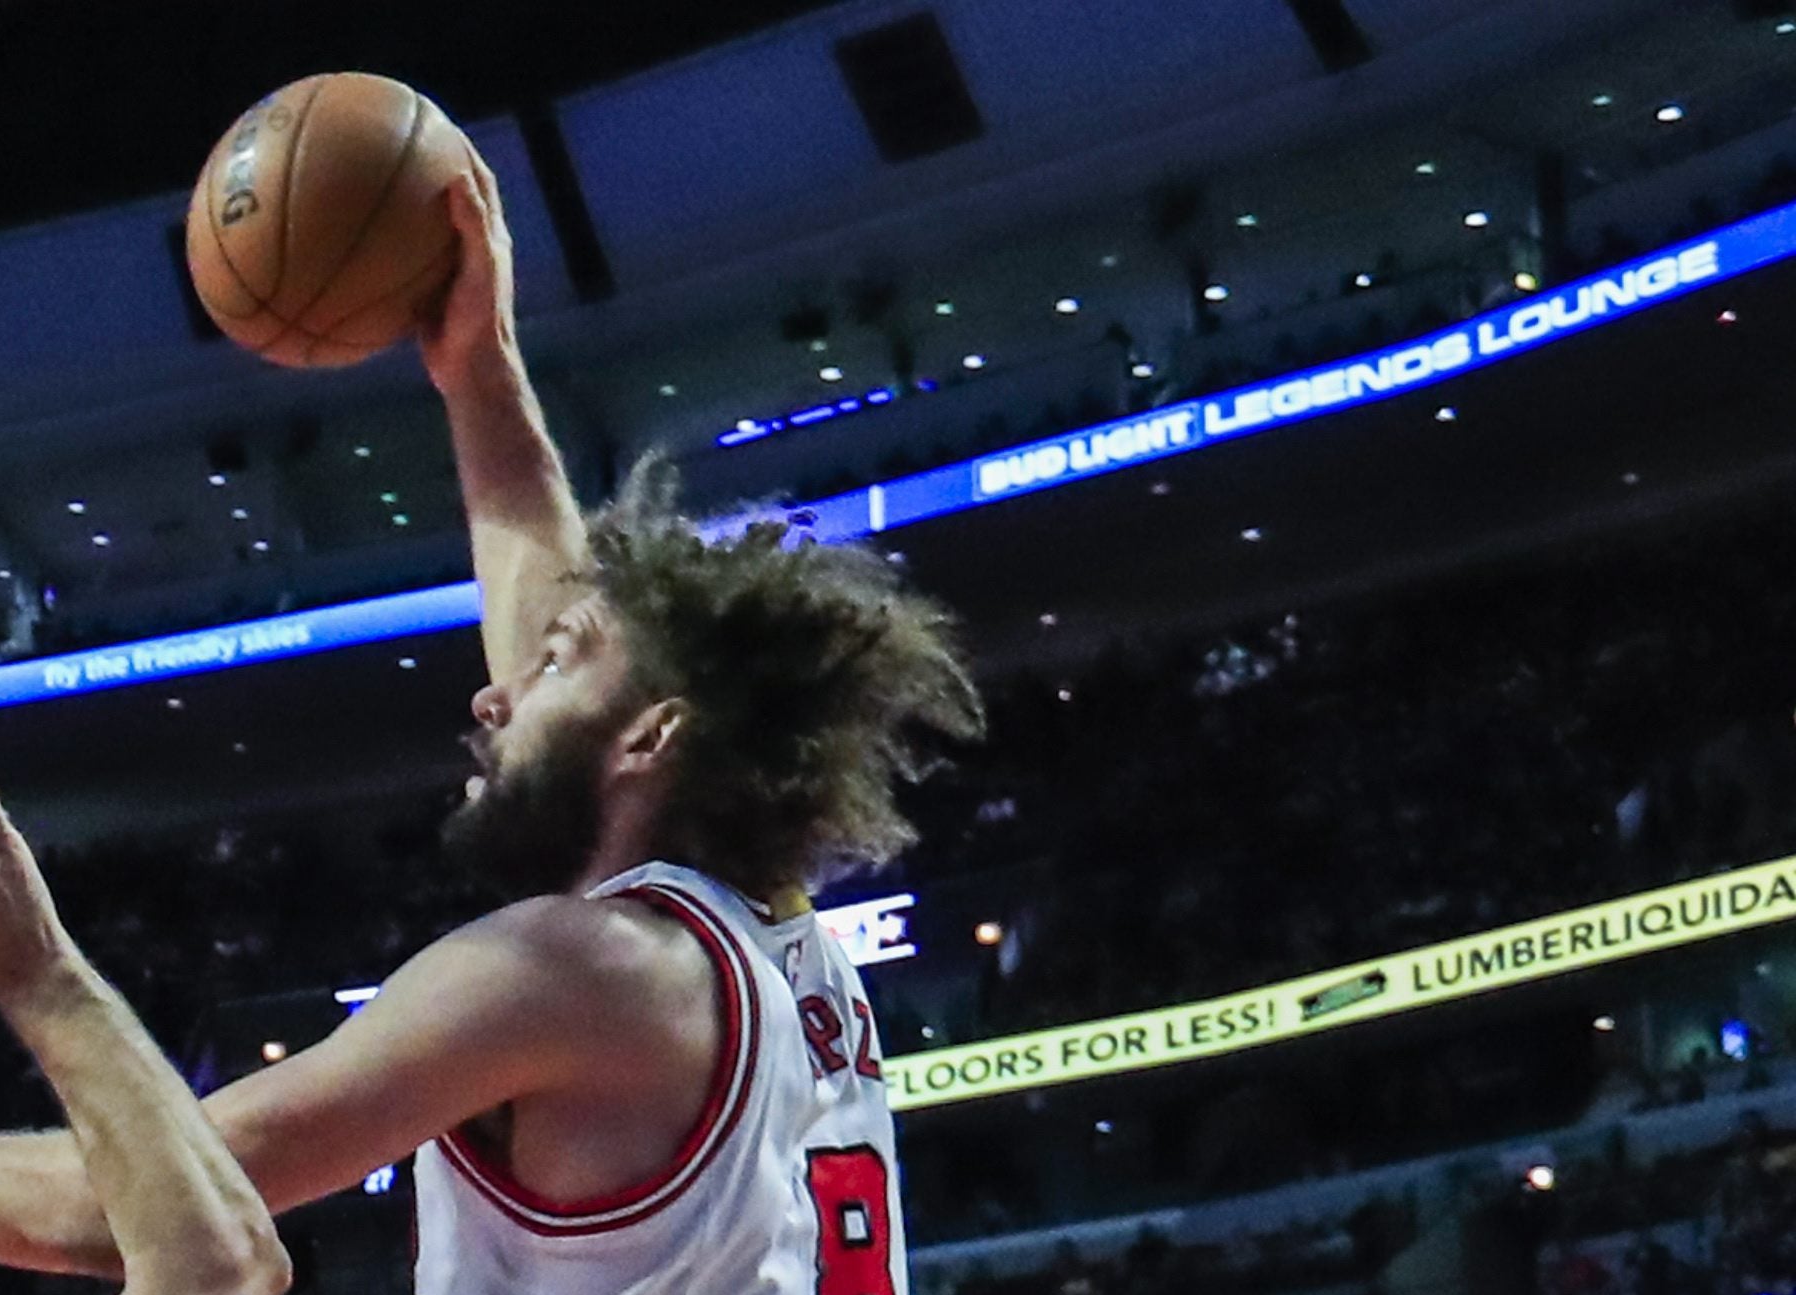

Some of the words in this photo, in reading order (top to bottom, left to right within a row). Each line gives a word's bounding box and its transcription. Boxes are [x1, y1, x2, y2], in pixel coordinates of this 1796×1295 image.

[979, 445, 1067, 495] BUD
[1069, 409, 1194, 477] LIGHT
[1205, 332, 1472, 437] LEGENDS
[1478, 240, 1720, 356] LOUNGE
[44, 661, 80, 689] fly
[85, 655, 128, 682] the
[132, 634, 237, 673] friendly
[1062, 1027, 1146, 1068] FOR
[1166, 999, 1275, 1050] LESS!
